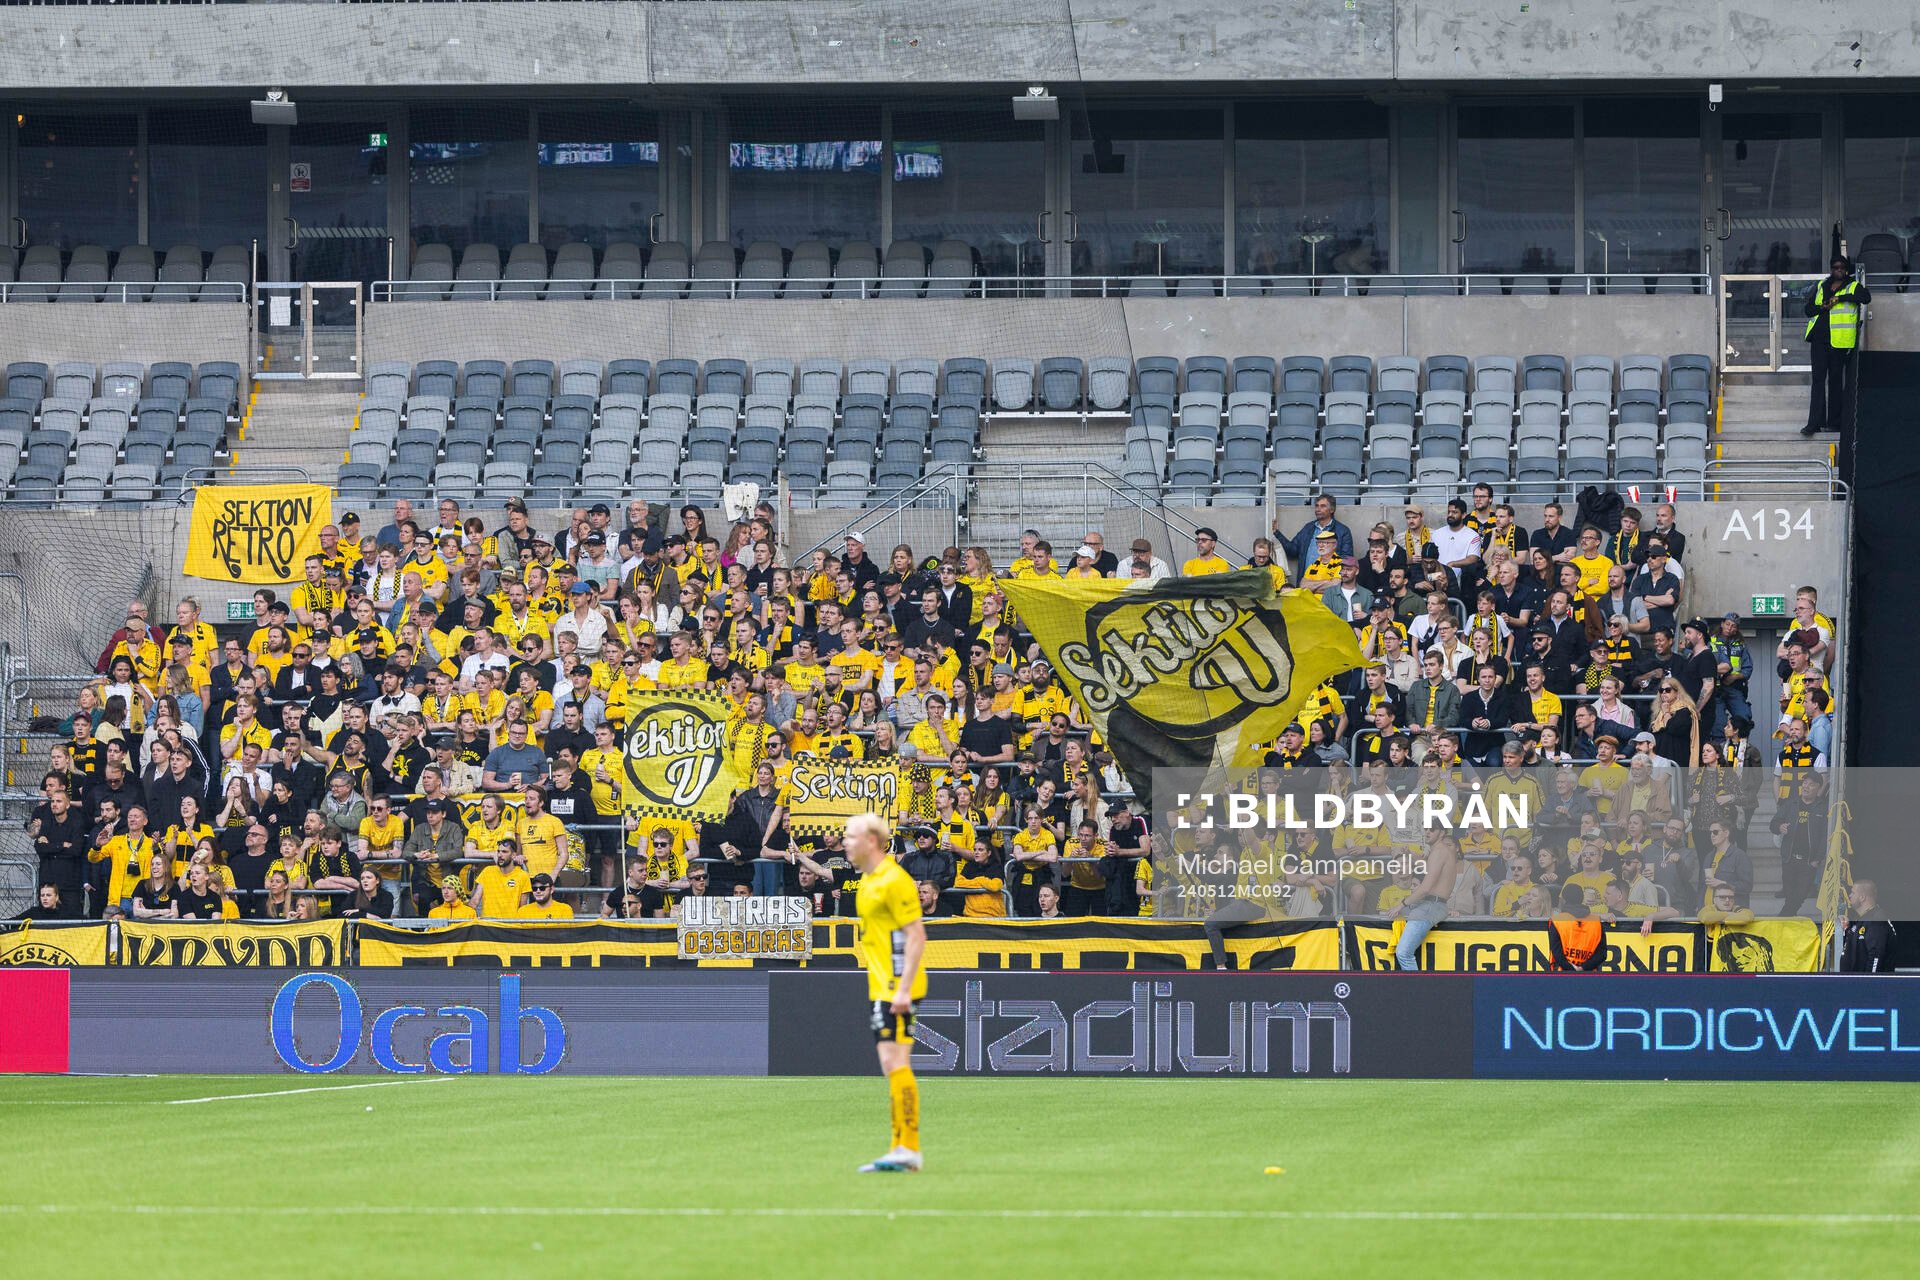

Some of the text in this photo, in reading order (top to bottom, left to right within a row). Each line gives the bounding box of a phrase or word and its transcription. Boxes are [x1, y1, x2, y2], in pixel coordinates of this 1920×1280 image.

[223, 496, 312, 527] SEKTION
[1722, 508, 1814, 540] A134
[212, 517, 296, 579] RETRO
[1190, 613, 1295, 708] U
[665, 754, 715, 808] U
[791, 764, 897, 804] Sektion
[683, 896, 807, 926] ULTRAS
[270, 972, 568, 1074] Ocab
